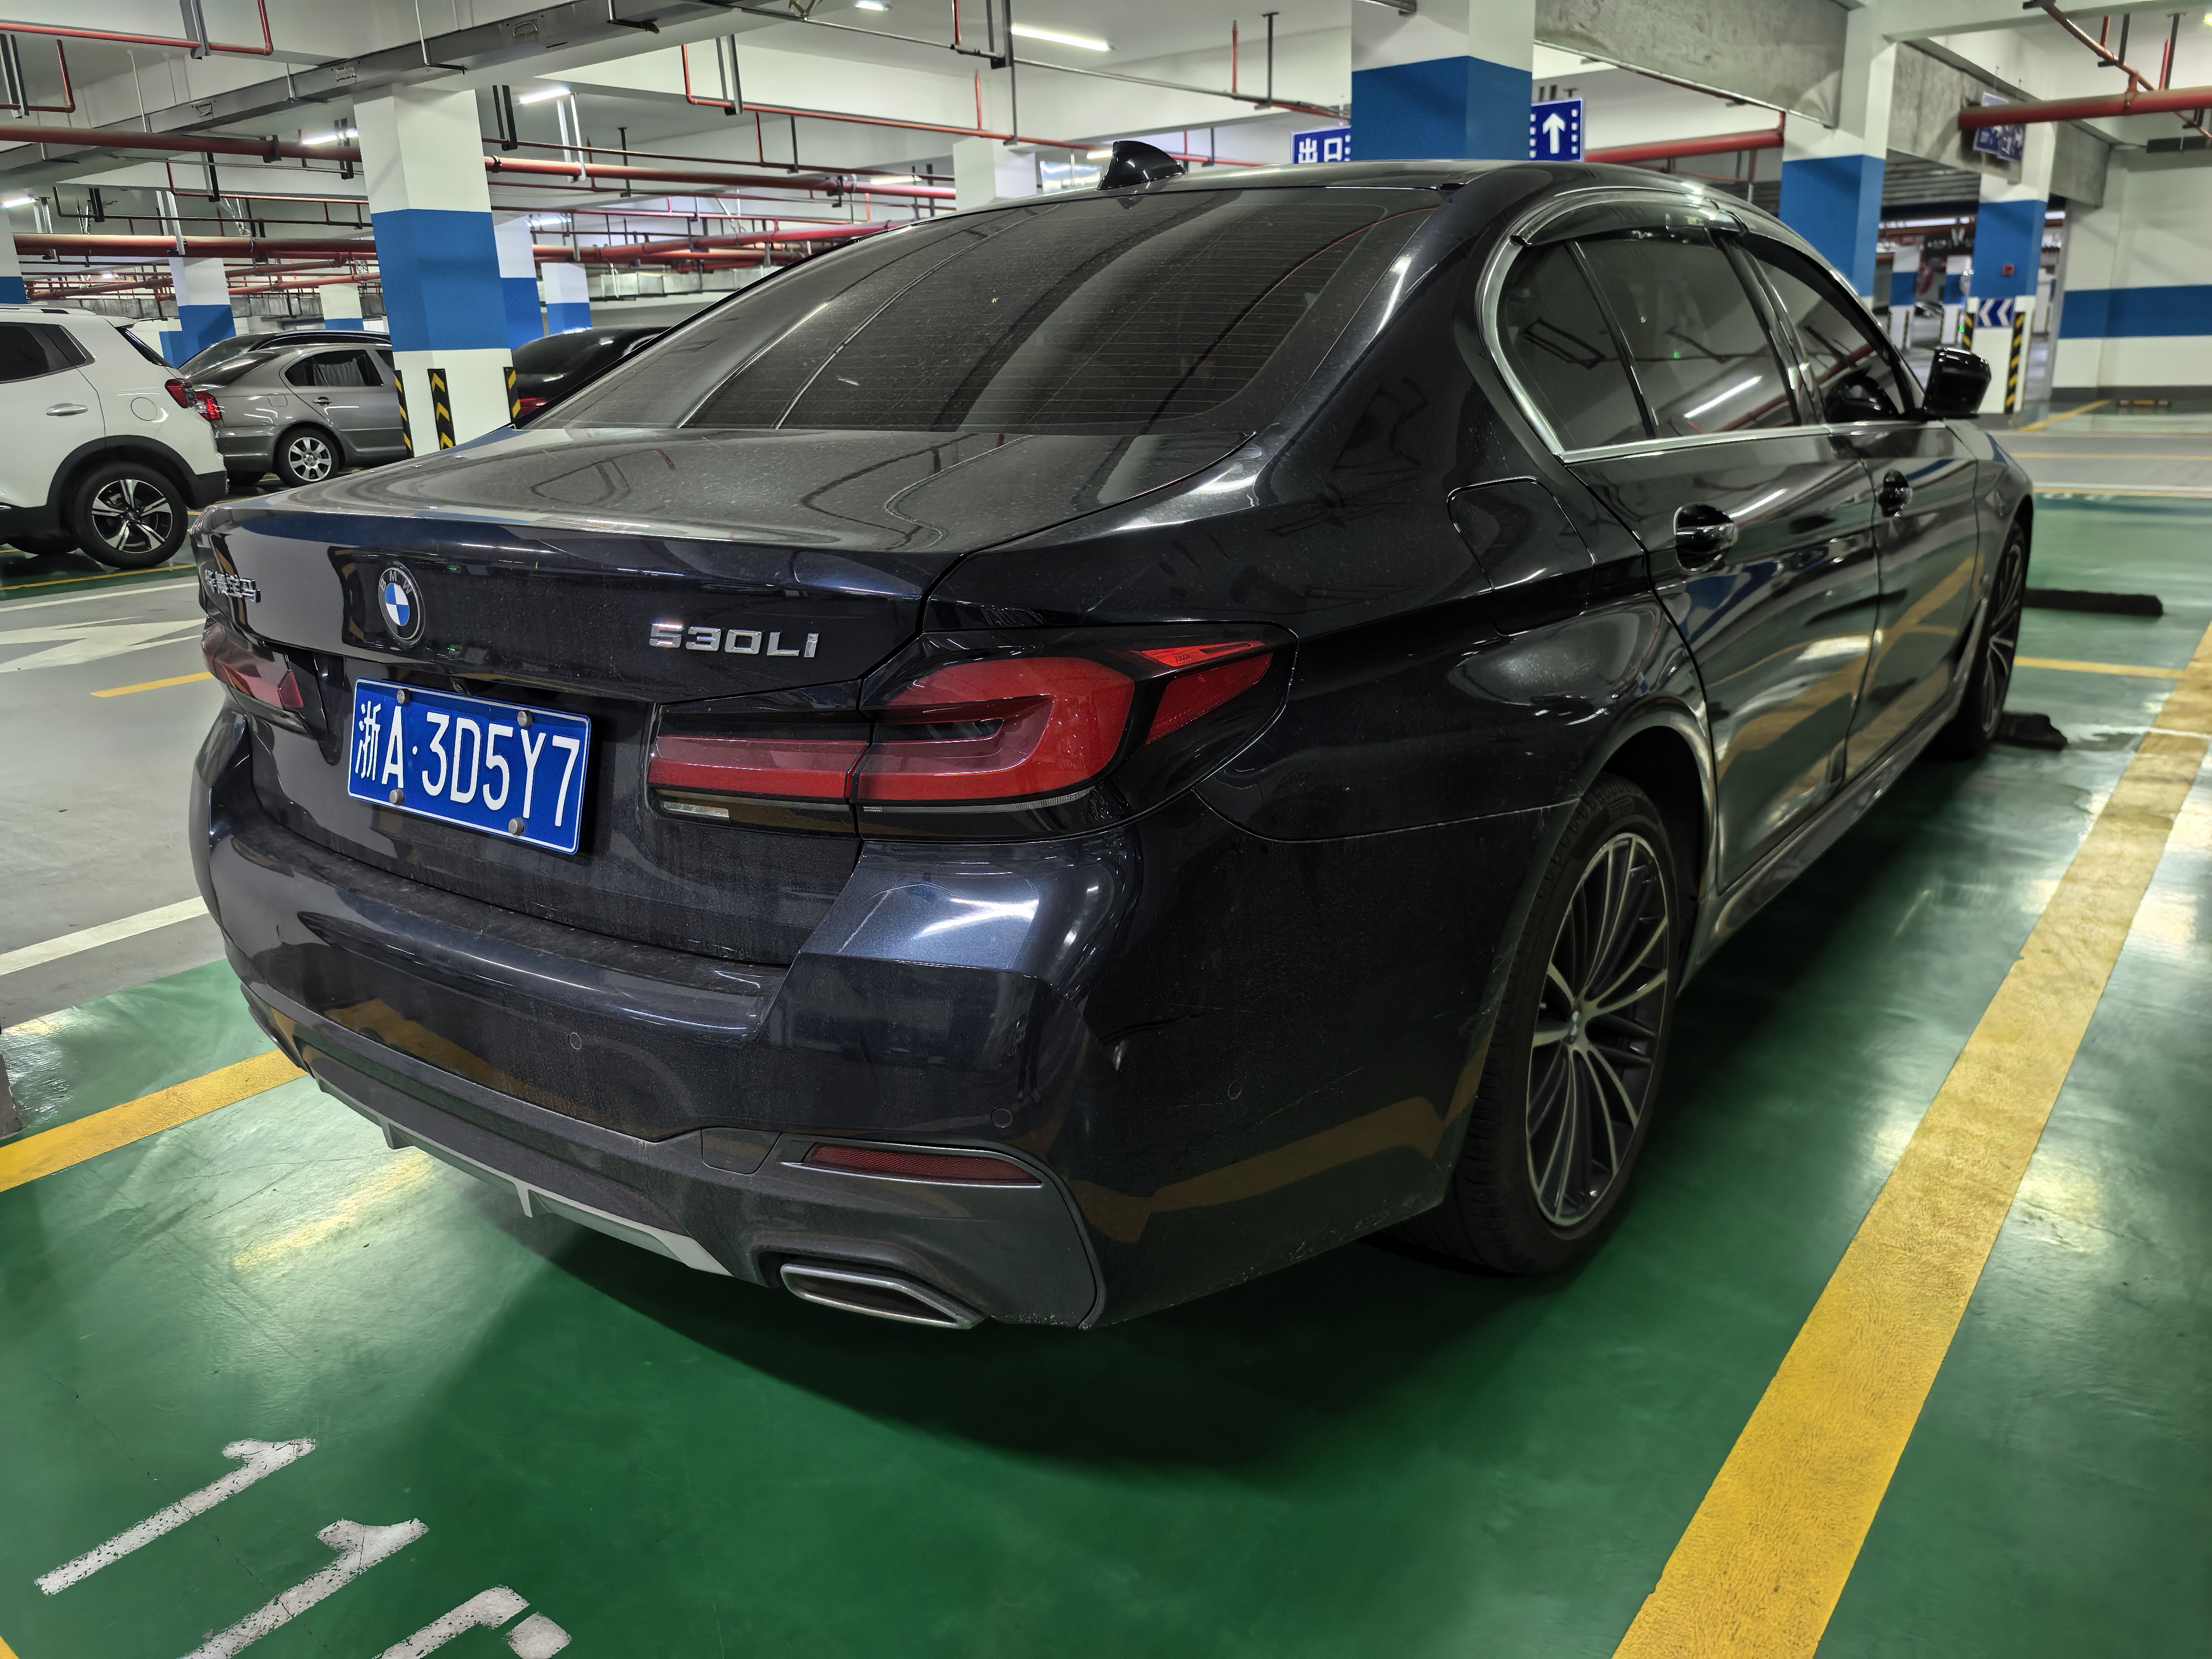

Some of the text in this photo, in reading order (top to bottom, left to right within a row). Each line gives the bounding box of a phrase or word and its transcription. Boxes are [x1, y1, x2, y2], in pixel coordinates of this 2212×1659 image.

[1298, 138, 1343, 163] 出口
[380, 570, 413, 595] BMW
[649, 623, 819, 658] 530Li
